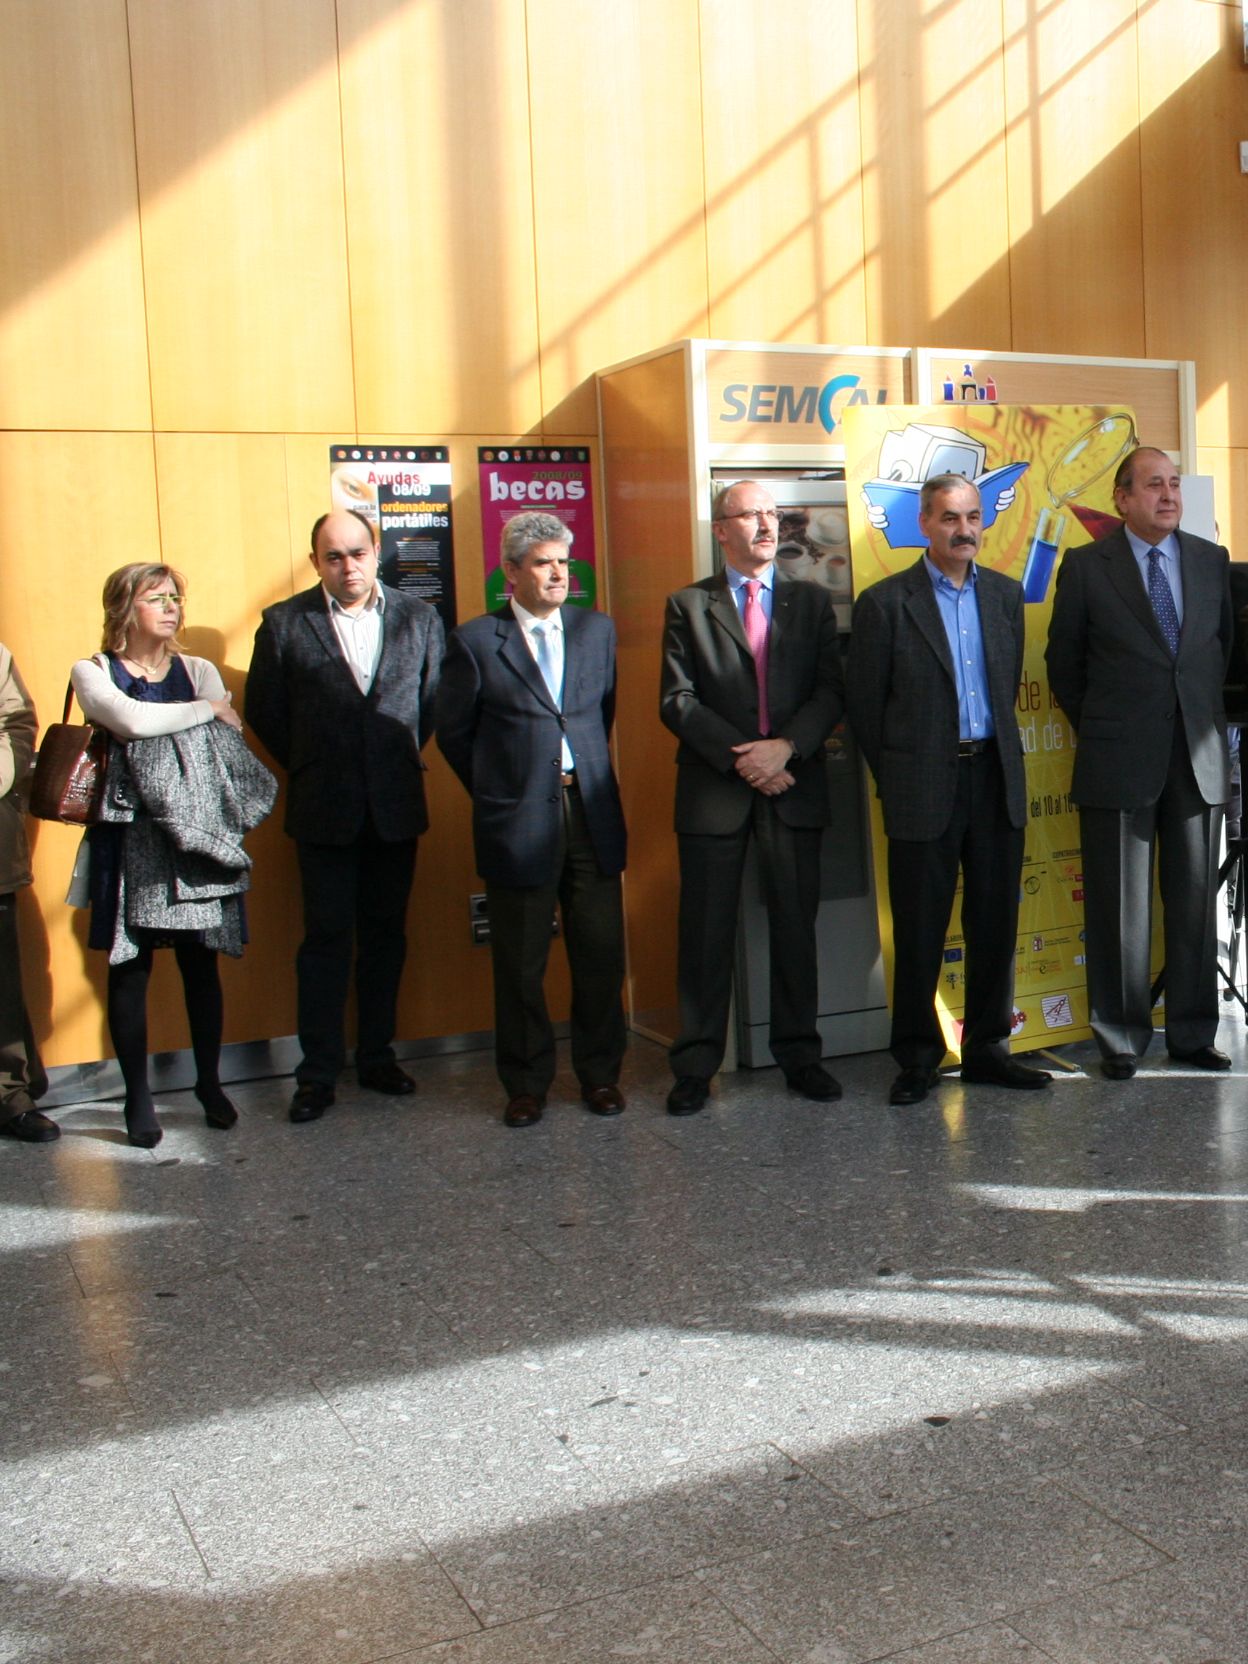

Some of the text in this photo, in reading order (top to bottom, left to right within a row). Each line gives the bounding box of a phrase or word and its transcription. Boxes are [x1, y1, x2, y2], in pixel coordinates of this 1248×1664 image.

[367, 471, 421, 486] Ayudas
[489, 472, 586, 502] becas
[392, 484, 431, 496] 08/09
[381, 501, 449, 512] ordenadores
[381, 513, 449, 531] portátiles
[1017, 671, 1041, 712] de
[1043, 714, 1063, 750] de
[1030, 796, 1042, 818] del
[1044, 794, 1053, 816] 10
